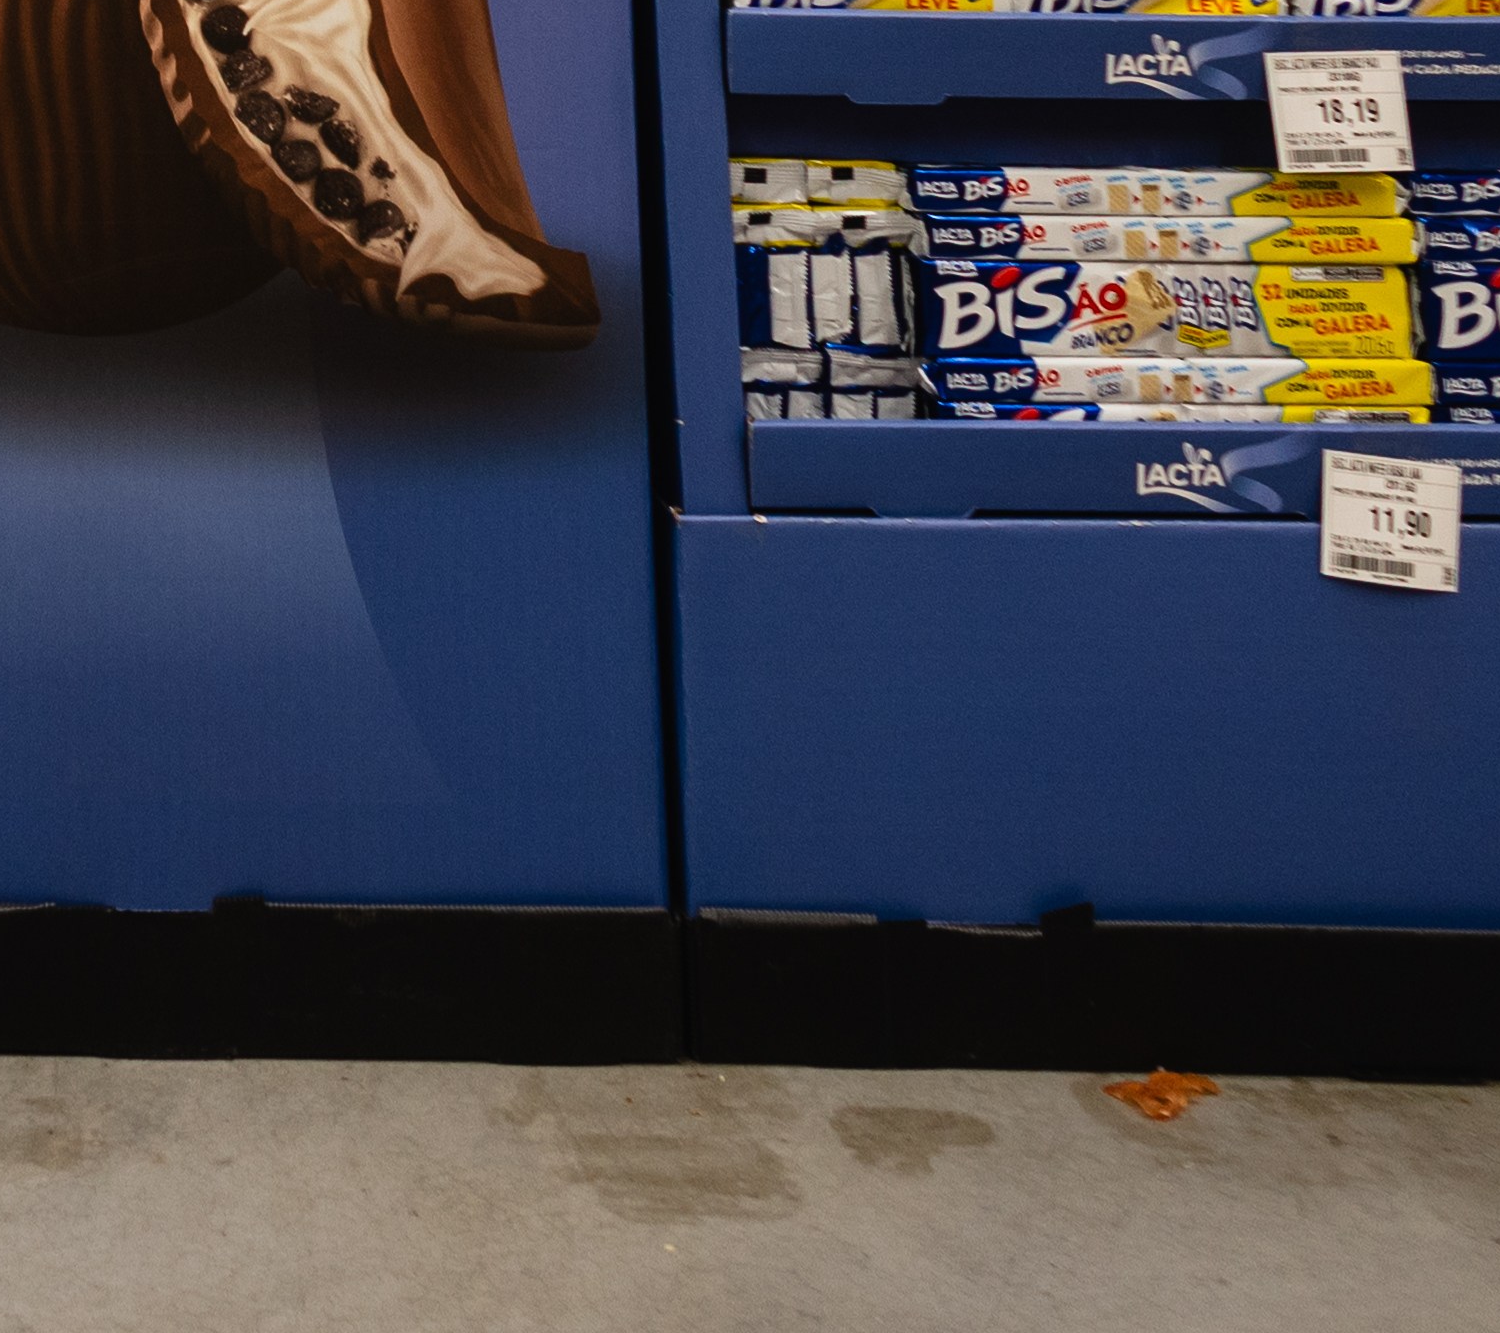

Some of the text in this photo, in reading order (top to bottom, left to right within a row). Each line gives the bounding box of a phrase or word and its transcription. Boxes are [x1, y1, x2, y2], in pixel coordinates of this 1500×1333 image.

[1105, 52, 1192, 84] LACTA
[1317, 98, 1380, 128] 18,19
[1314, 315, 1393, 335] GALERA
[1137, 461, 1227, 496] LACTA
[1369, 505, 1432, 539] 11,90
